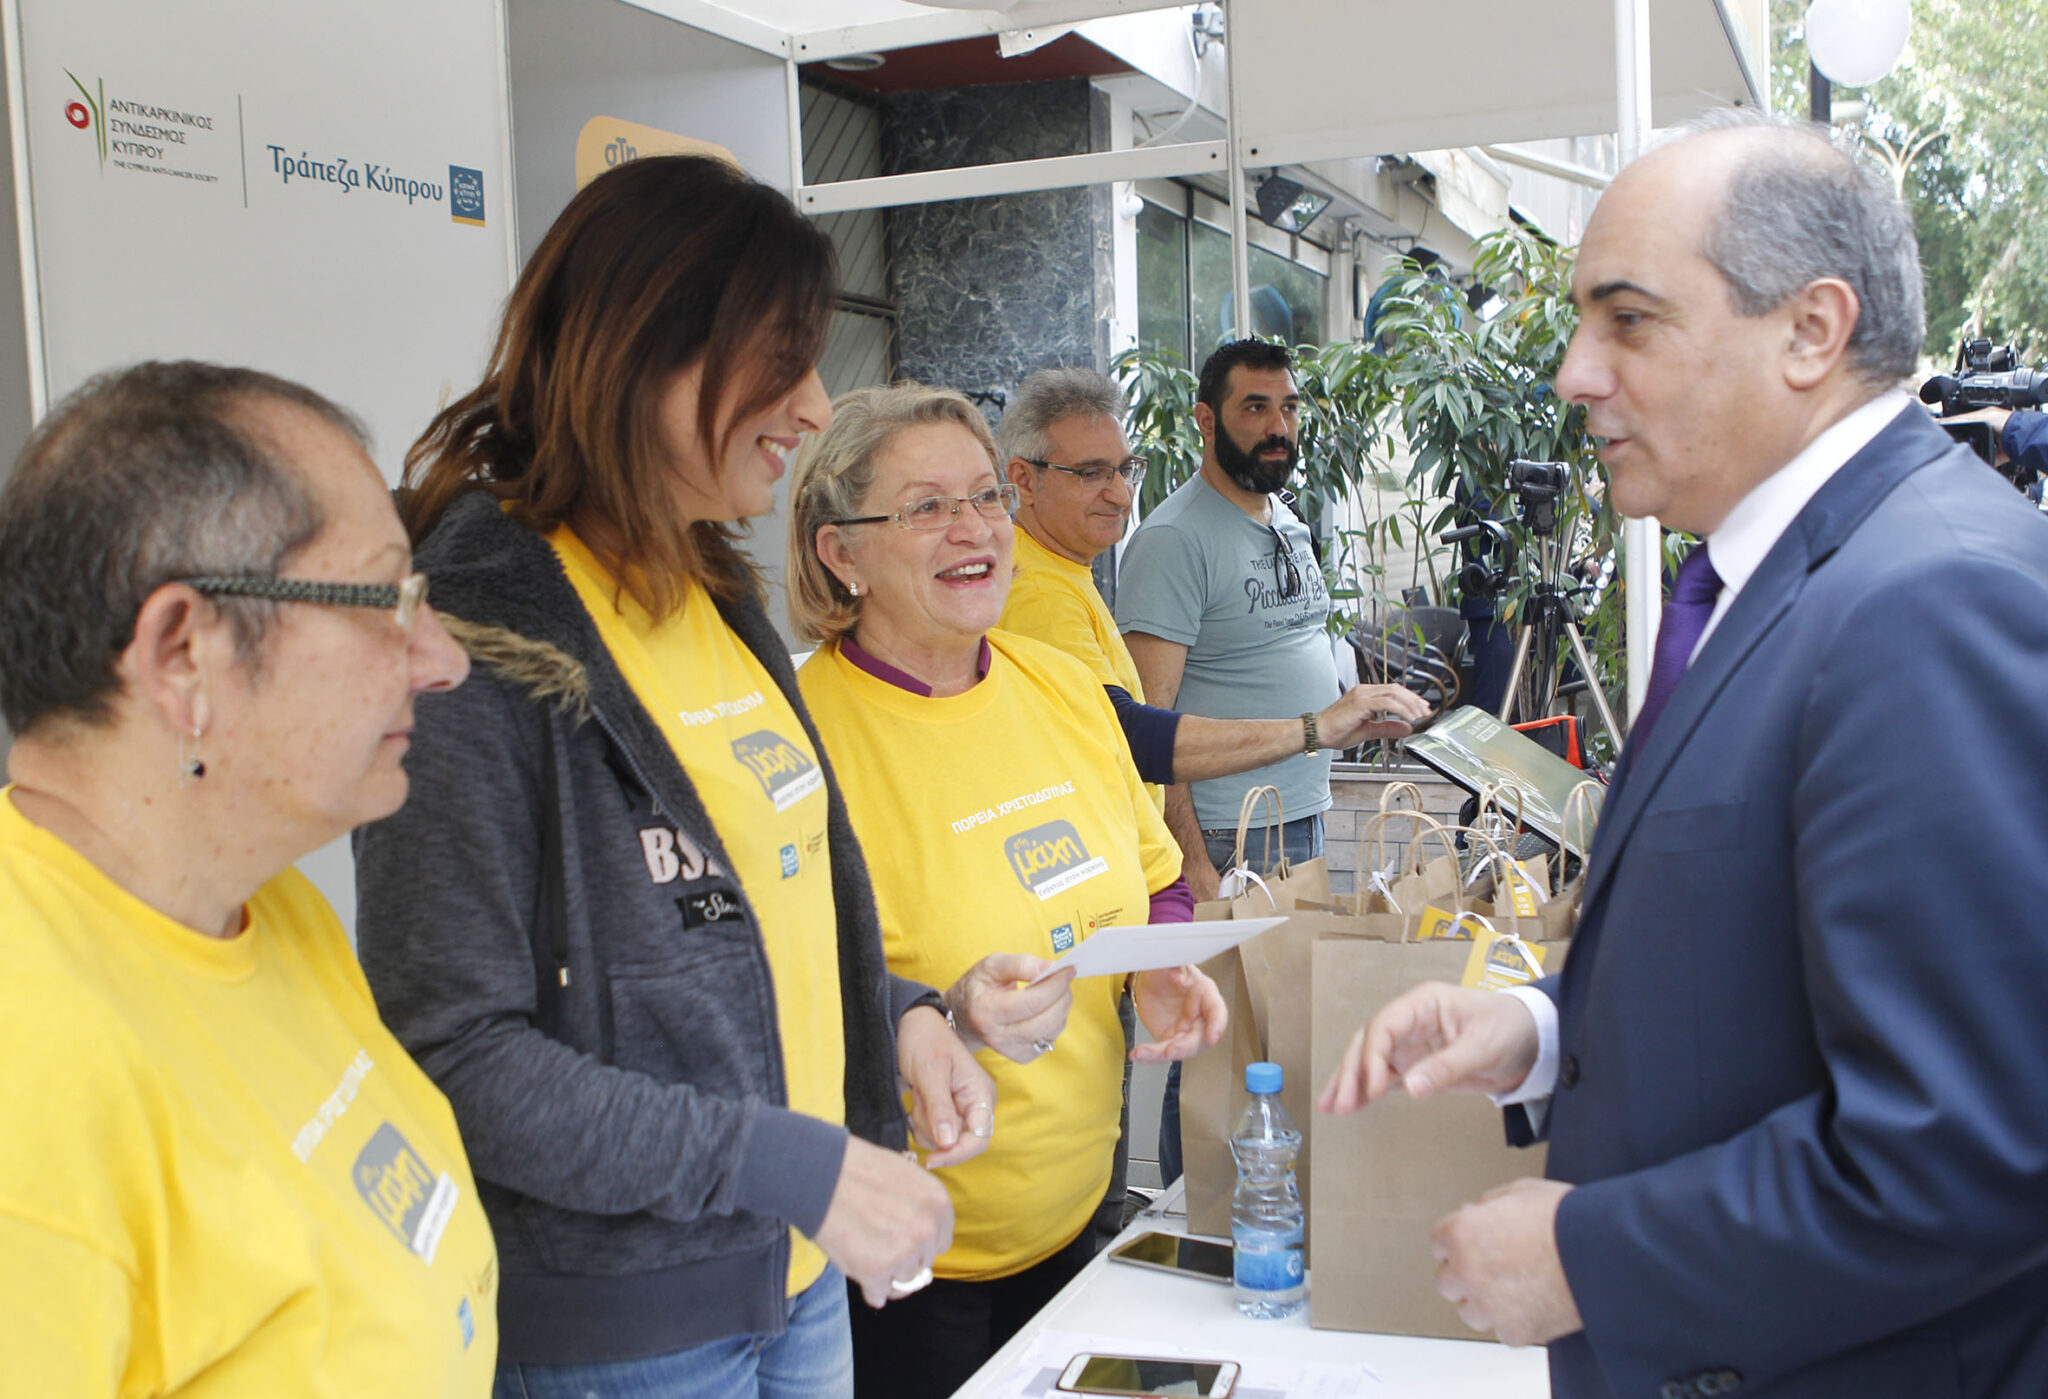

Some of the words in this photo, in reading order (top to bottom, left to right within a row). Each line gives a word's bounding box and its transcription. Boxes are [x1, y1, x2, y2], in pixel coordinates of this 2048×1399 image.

[109, 98, 215, 131] ΑΝΤΙΚΑΡΚΙΝΙΚΟΣ
[110, 118, 187, 145] ΣΥΝΔΕΣΜΟΣ
[111, 139, 164, 160] ΚΥΠΡΟΥ
[266, 144, 360, 194] Τράπεζα
[364, 163, 444, 205] Κύπρου
[951, 808, 998, 836] ΠΟΡΕΙΑ
[996, 780, 1077, 817] ΧΡΙΣΤΟΔΟΥΛΑΣ
[639, 826, 725, 885] BS
[1013, 835, 1084, 886] μάχη
